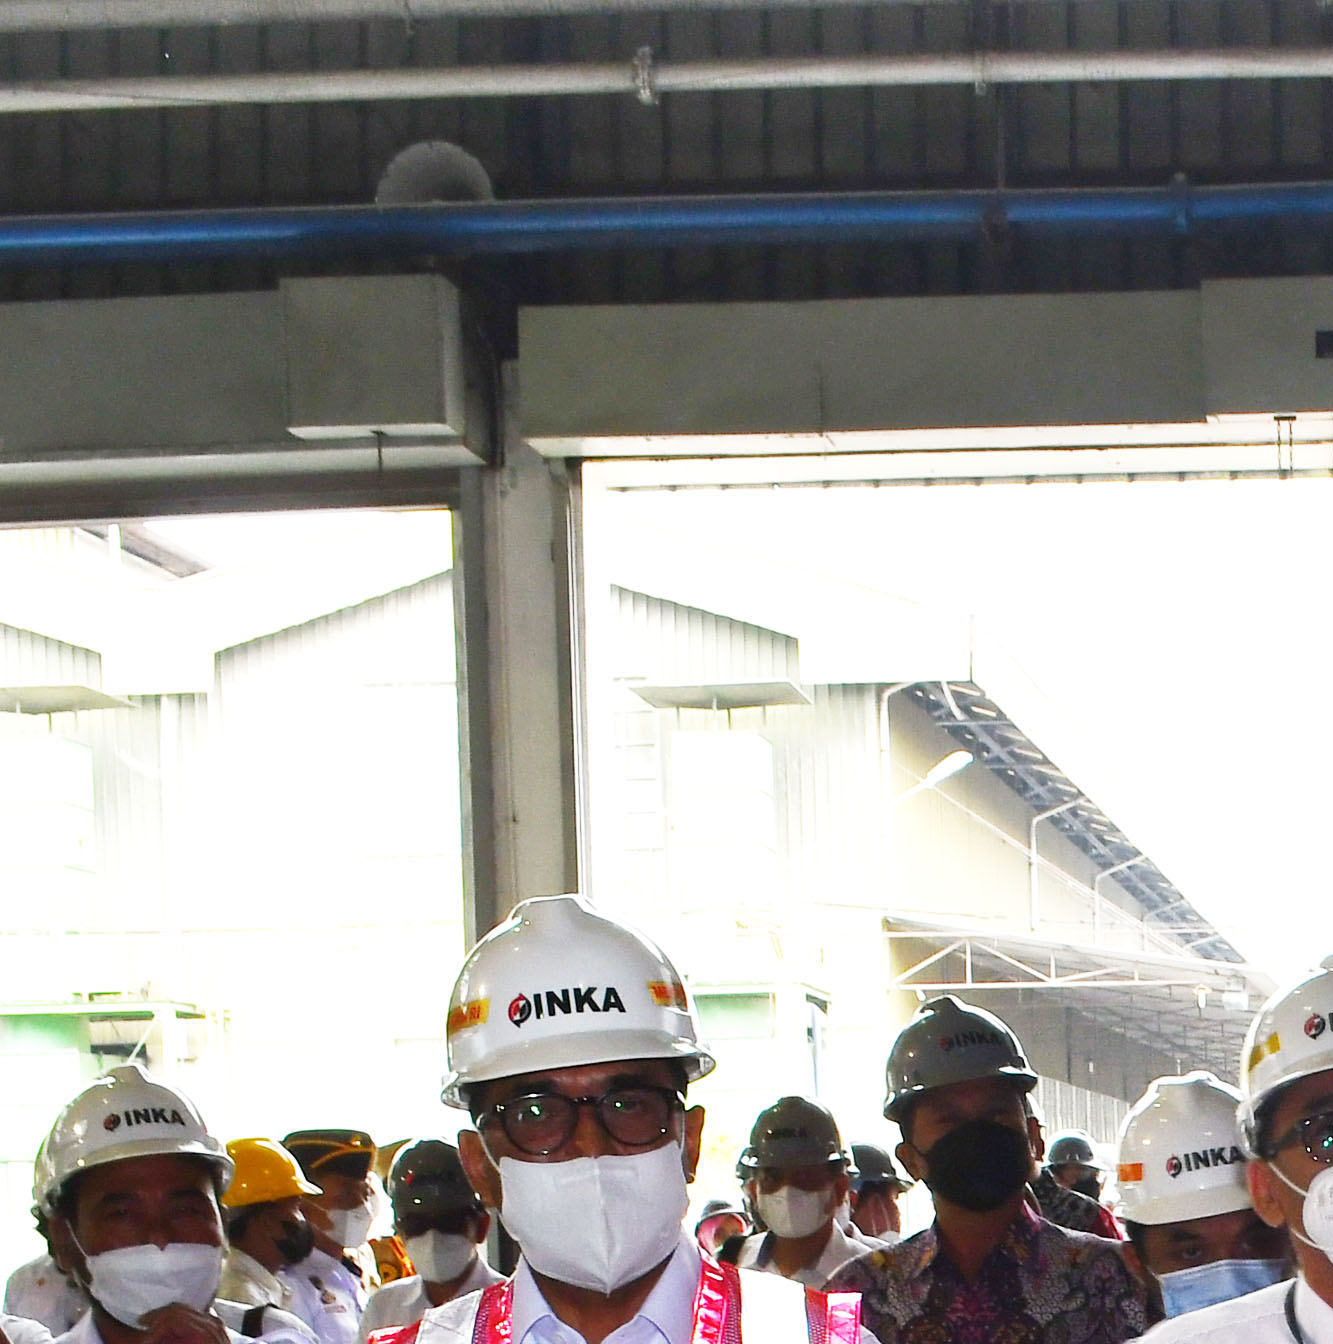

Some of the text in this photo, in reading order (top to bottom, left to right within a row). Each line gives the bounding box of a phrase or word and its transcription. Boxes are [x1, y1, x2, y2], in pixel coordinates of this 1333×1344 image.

[534, 987, 627, 1020] INKA
[124, 1108, 186, 1127] INKA
[1183, 1146, 1246, 1172] INKA
